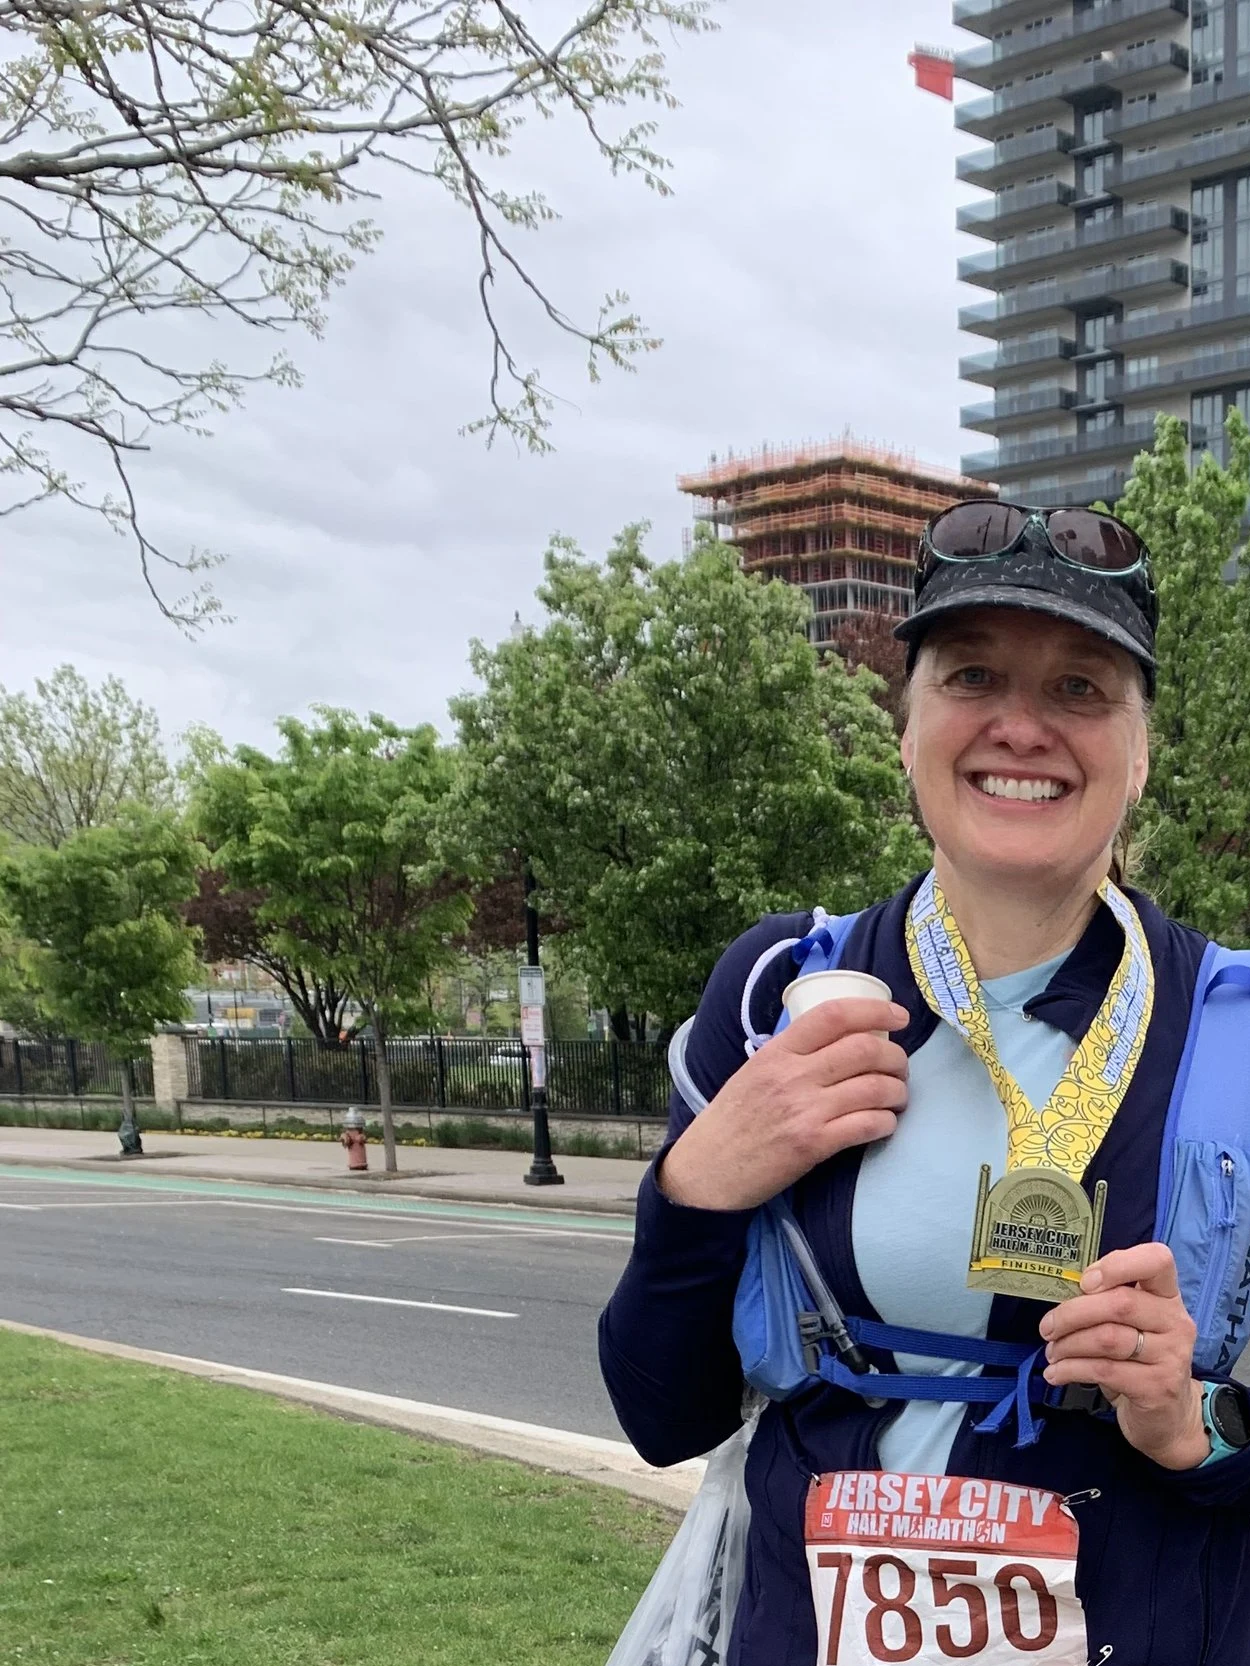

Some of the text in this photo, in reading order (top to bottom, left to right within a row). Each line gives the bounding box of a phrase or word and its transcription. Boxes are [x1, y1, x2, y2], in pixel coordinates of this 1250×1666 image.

[991, 1236, 1018, 1253] HALF
[994, 1221, 1079, 1248] JERSEY CITY
[1001, 1259, 1063, 1277] FINISHER
[826, 1472, 1054, 1526] JERSEY CITY
[847, 1513, 888, 1536] HALF
[891, 1514, 1006, 1543] MARATHON
[817, 1552, 1058, 1665] 7850
